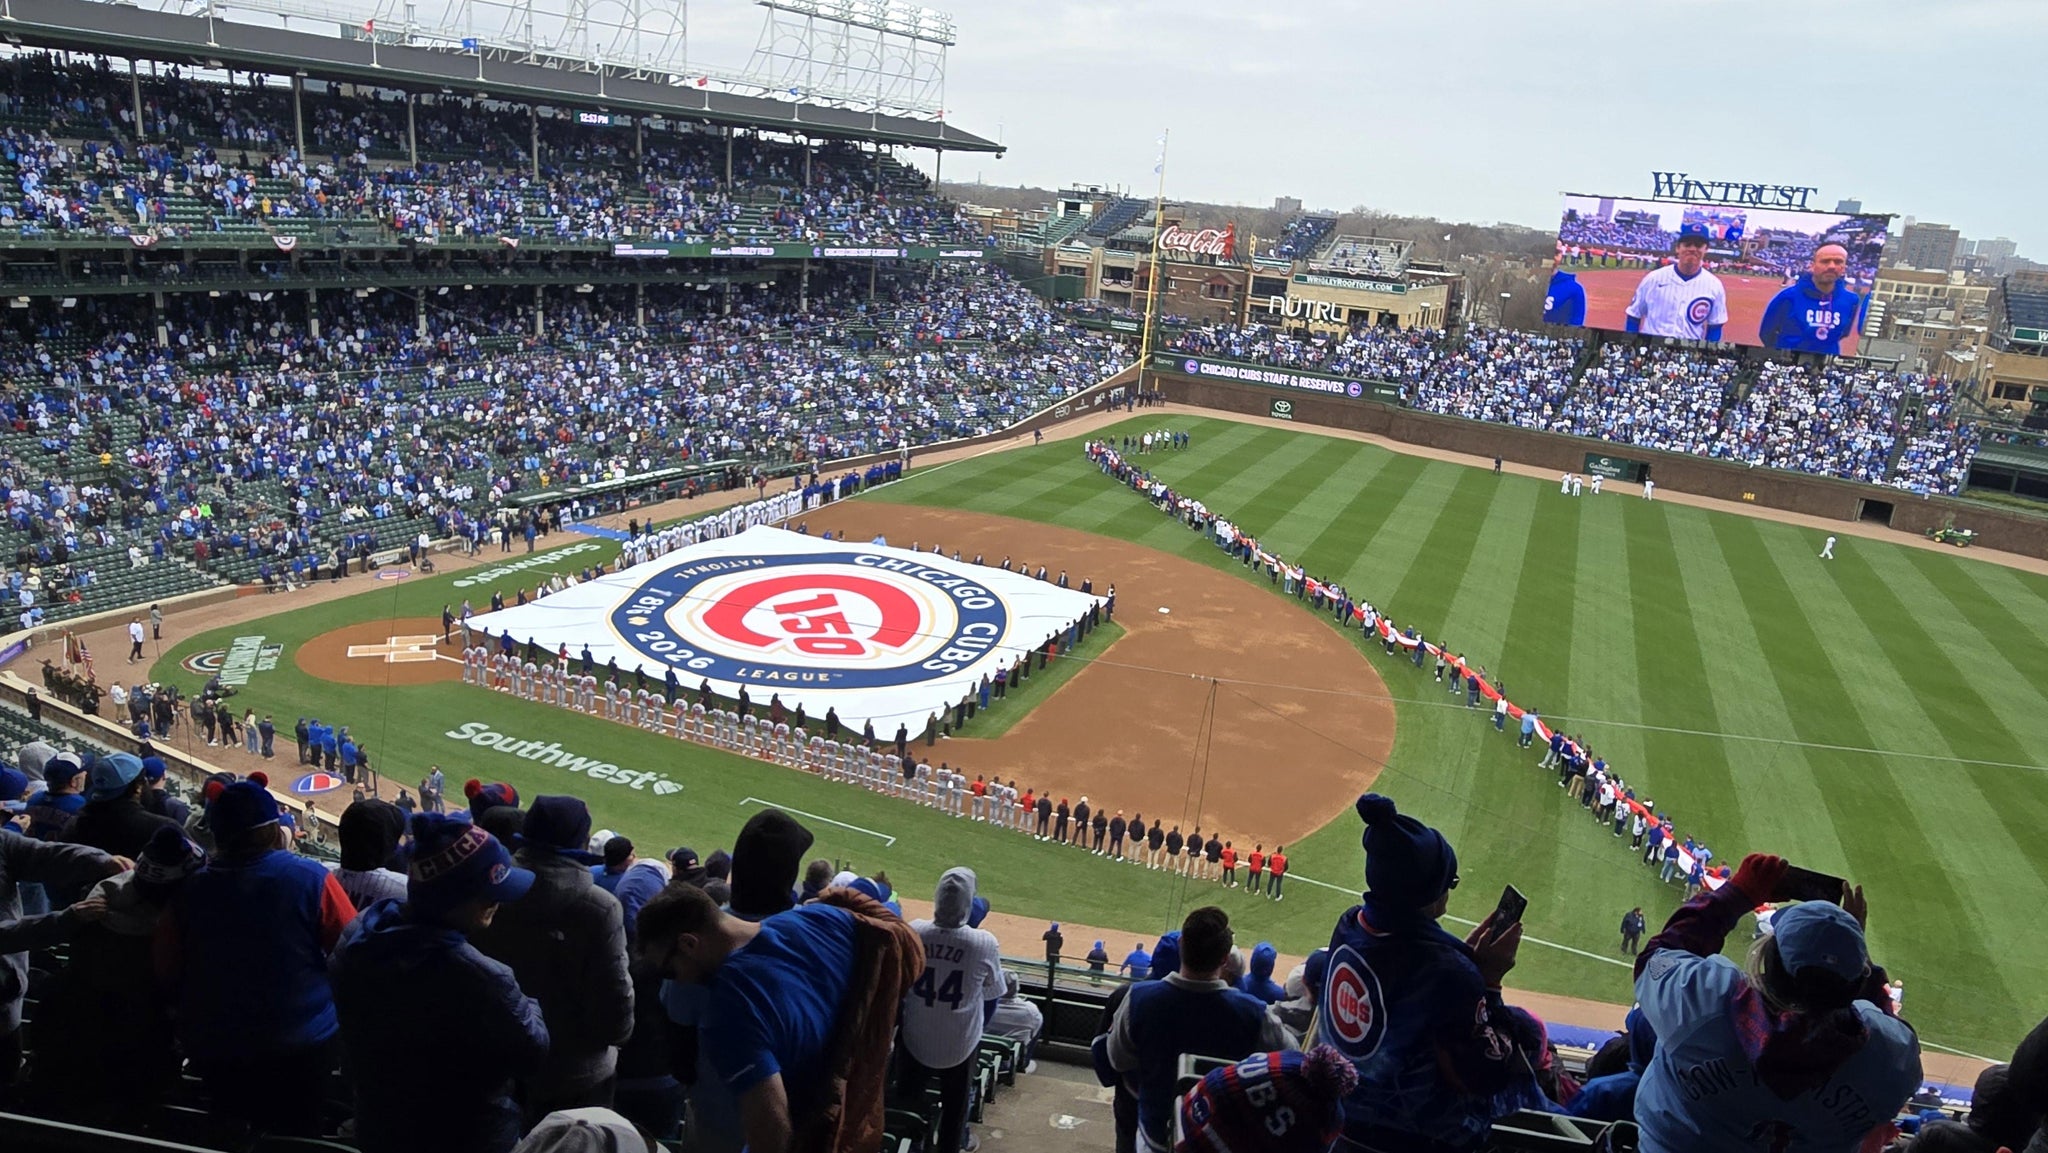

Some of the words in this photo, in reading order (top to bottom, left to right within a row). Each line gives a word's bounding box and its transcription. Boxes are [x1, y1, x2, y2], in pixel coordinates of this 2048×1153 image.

[1652, 171, 1818, 208] WINTRUST
[1806, 309, 1841, 326] CUBS
[1200, 363, 1238, 378] CHICAGO
[1238, 368, 1262, 382] CUBS
[1263, 371, 1290, 386] STAFF
[1290, 375, 1298, 387] &
[1299, 376, 1346, 394] RESERVES
[1271, 411, 1293, 420] TOYOTA
[674, 558, 766, 579] NATIONAL
[854, 554, 996, 610] CHICAGO
[773, 593, 867, 656] 150
[635, 630, 716, 669] 2026
[921, 621, 999, 673] CUBS
[444, 722, 663, 791] Southwest
[913, 966, 964, 1011] 44
